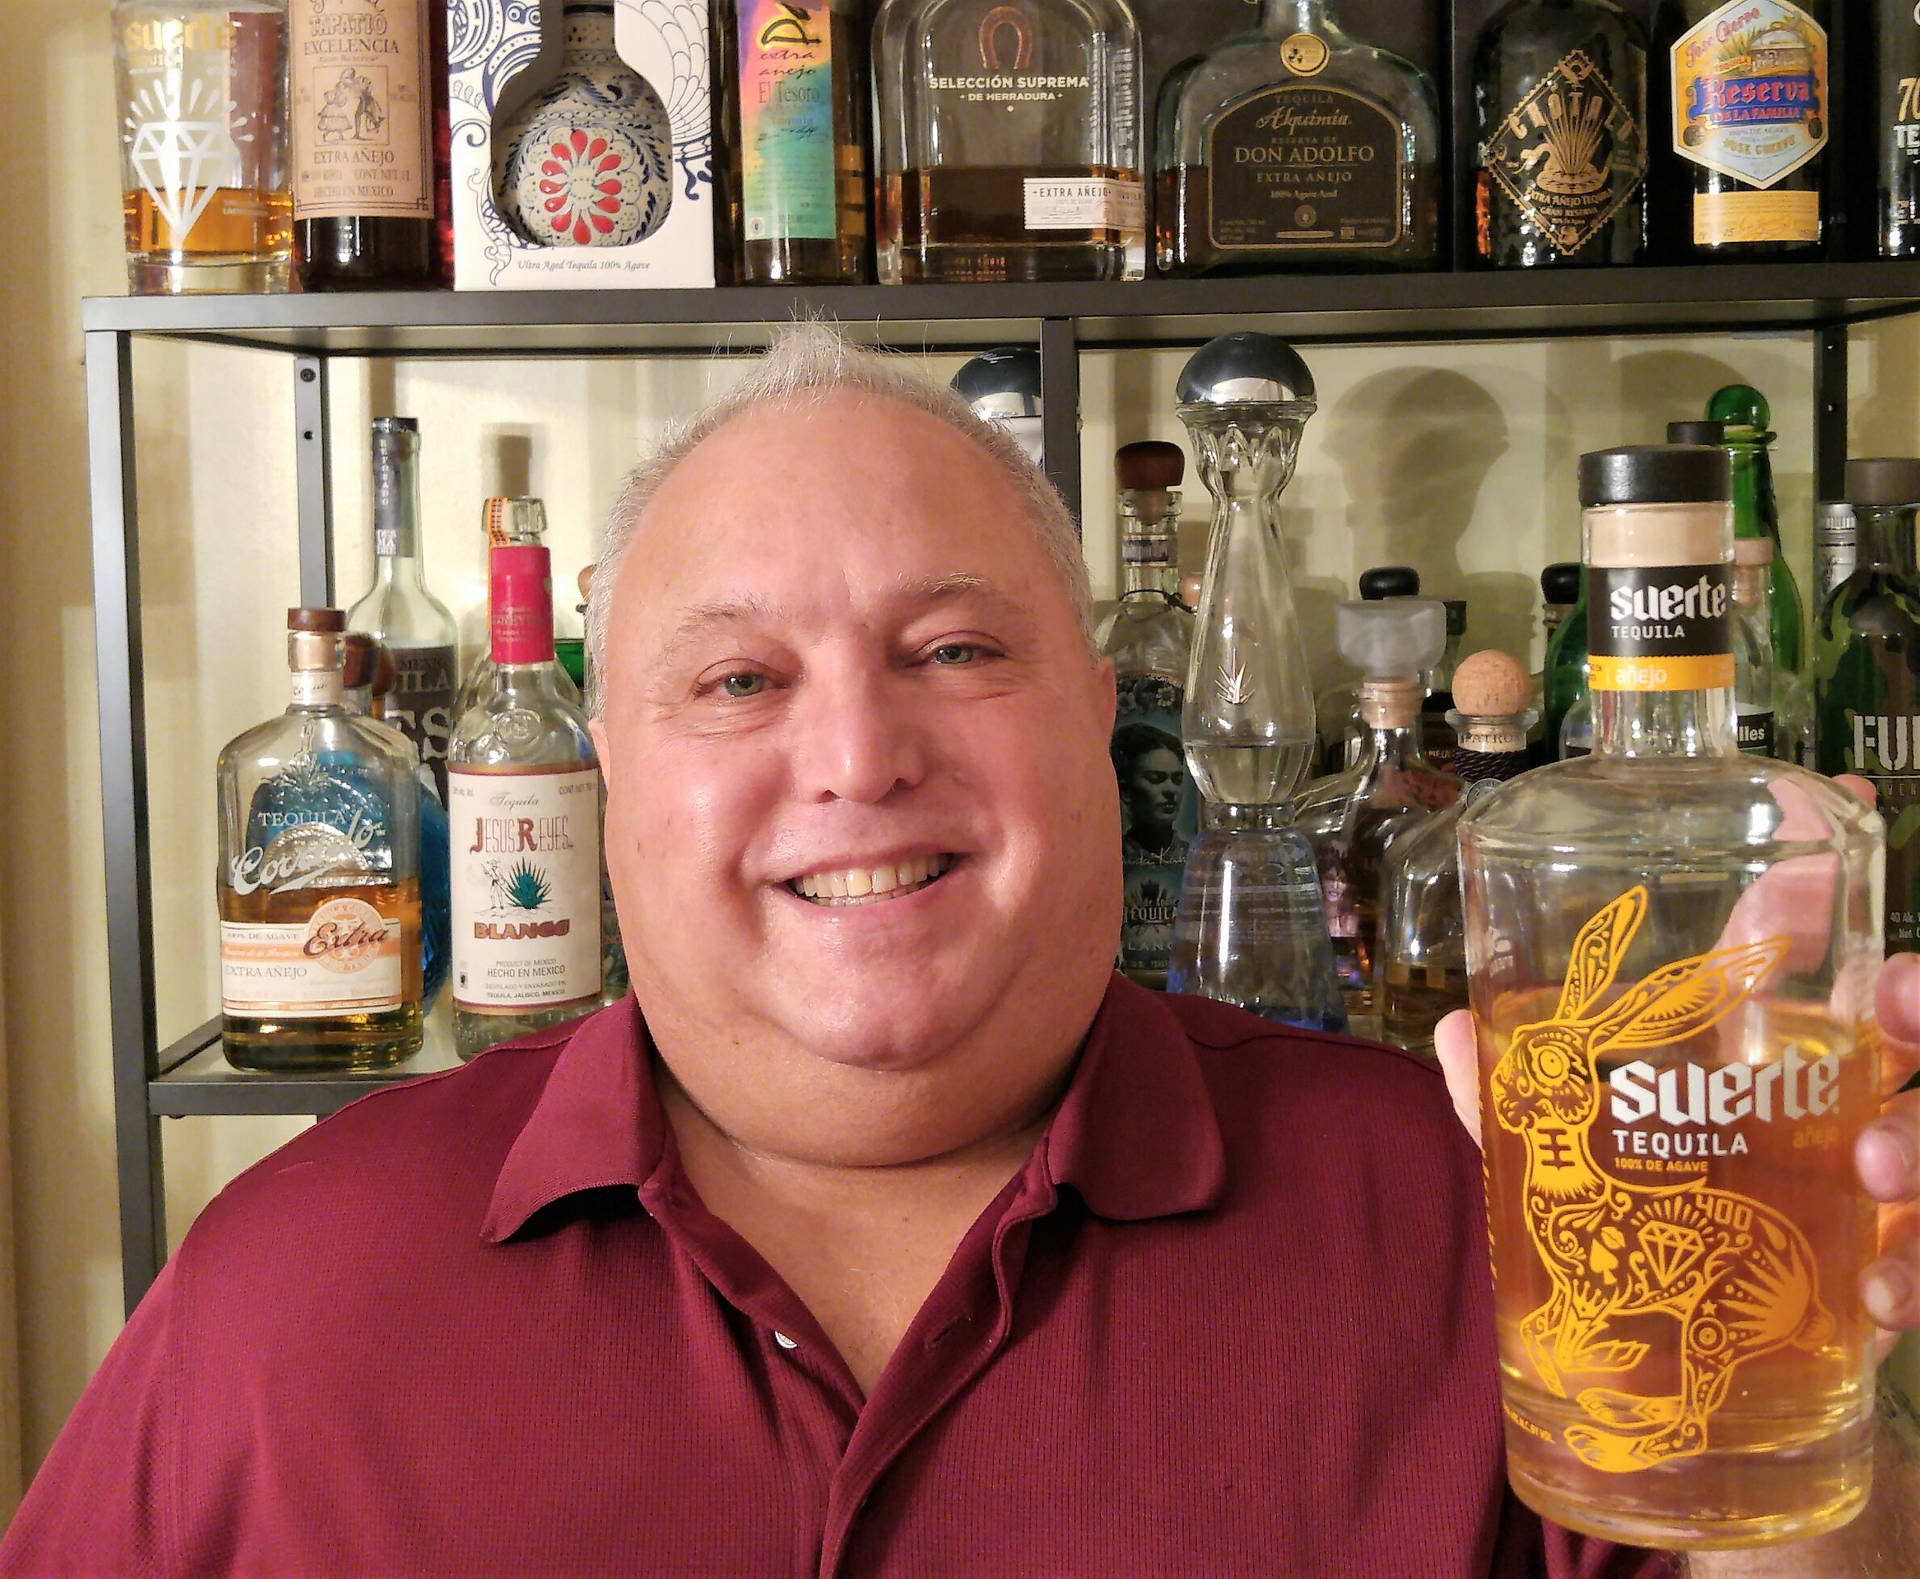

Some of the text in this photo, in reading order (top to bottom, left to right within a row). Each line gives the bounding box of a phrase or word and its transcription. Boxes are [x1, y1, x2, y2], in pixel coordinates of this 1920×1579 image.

[303, 39, 399, 56] EXCELENCIA
[929, 75, 1089, 90] SELECCIÓN SUPREMA
[759, 80, 820, 104] El Tesoro
[968, 91, 1056, 102] DE HERRADURA
[1701, 78, 1809, 111] Reserva
[1733, 109, 1749, 121] LA
[1751, 107, 1800, 119] FAMILIA
[313, 148, 395, 167] EXTRA AÑEJO
[1234, 145, 1375, 163] DON ADOLFO
[1256, 170, 1353, 184] EXTRA AÑEJO
[1039, 187, 1073, 198] EXTRA
[1078, 185, 1108, 198] AÑEJO
[517, 260, 651, 272] Ultra Aged Tequila 100% Agave
[1610, 574, 1727, 622] suerte
[1611, 625, 1686, 641] TEQUILA
[1616, 665, 1668, 689] añejo
[1461, 733, 1514, 744] PATRO
[488, 791, 540, 811] Tequila
[258, 811, 346, 828] TEQUILA
[470, 815, 569, 854] JESUS REYES
[265, 932, 298, 940] AGAVE
[474, 918, 571, 940] BLANCO
[303, 919, 390, 957] Extra
[225, 965, 262, 978] EXTRA
[487, 965, 566, 977] HECHO EN MEXICO
[1609, 1043, 1840, 1127] suerte
[1612, 1129, 1748, 1159] TEQUILA
[1614, 1156, 1708, 1173] 100% DE AGAVE
[1695, 1192, 1753, 1232] 400
